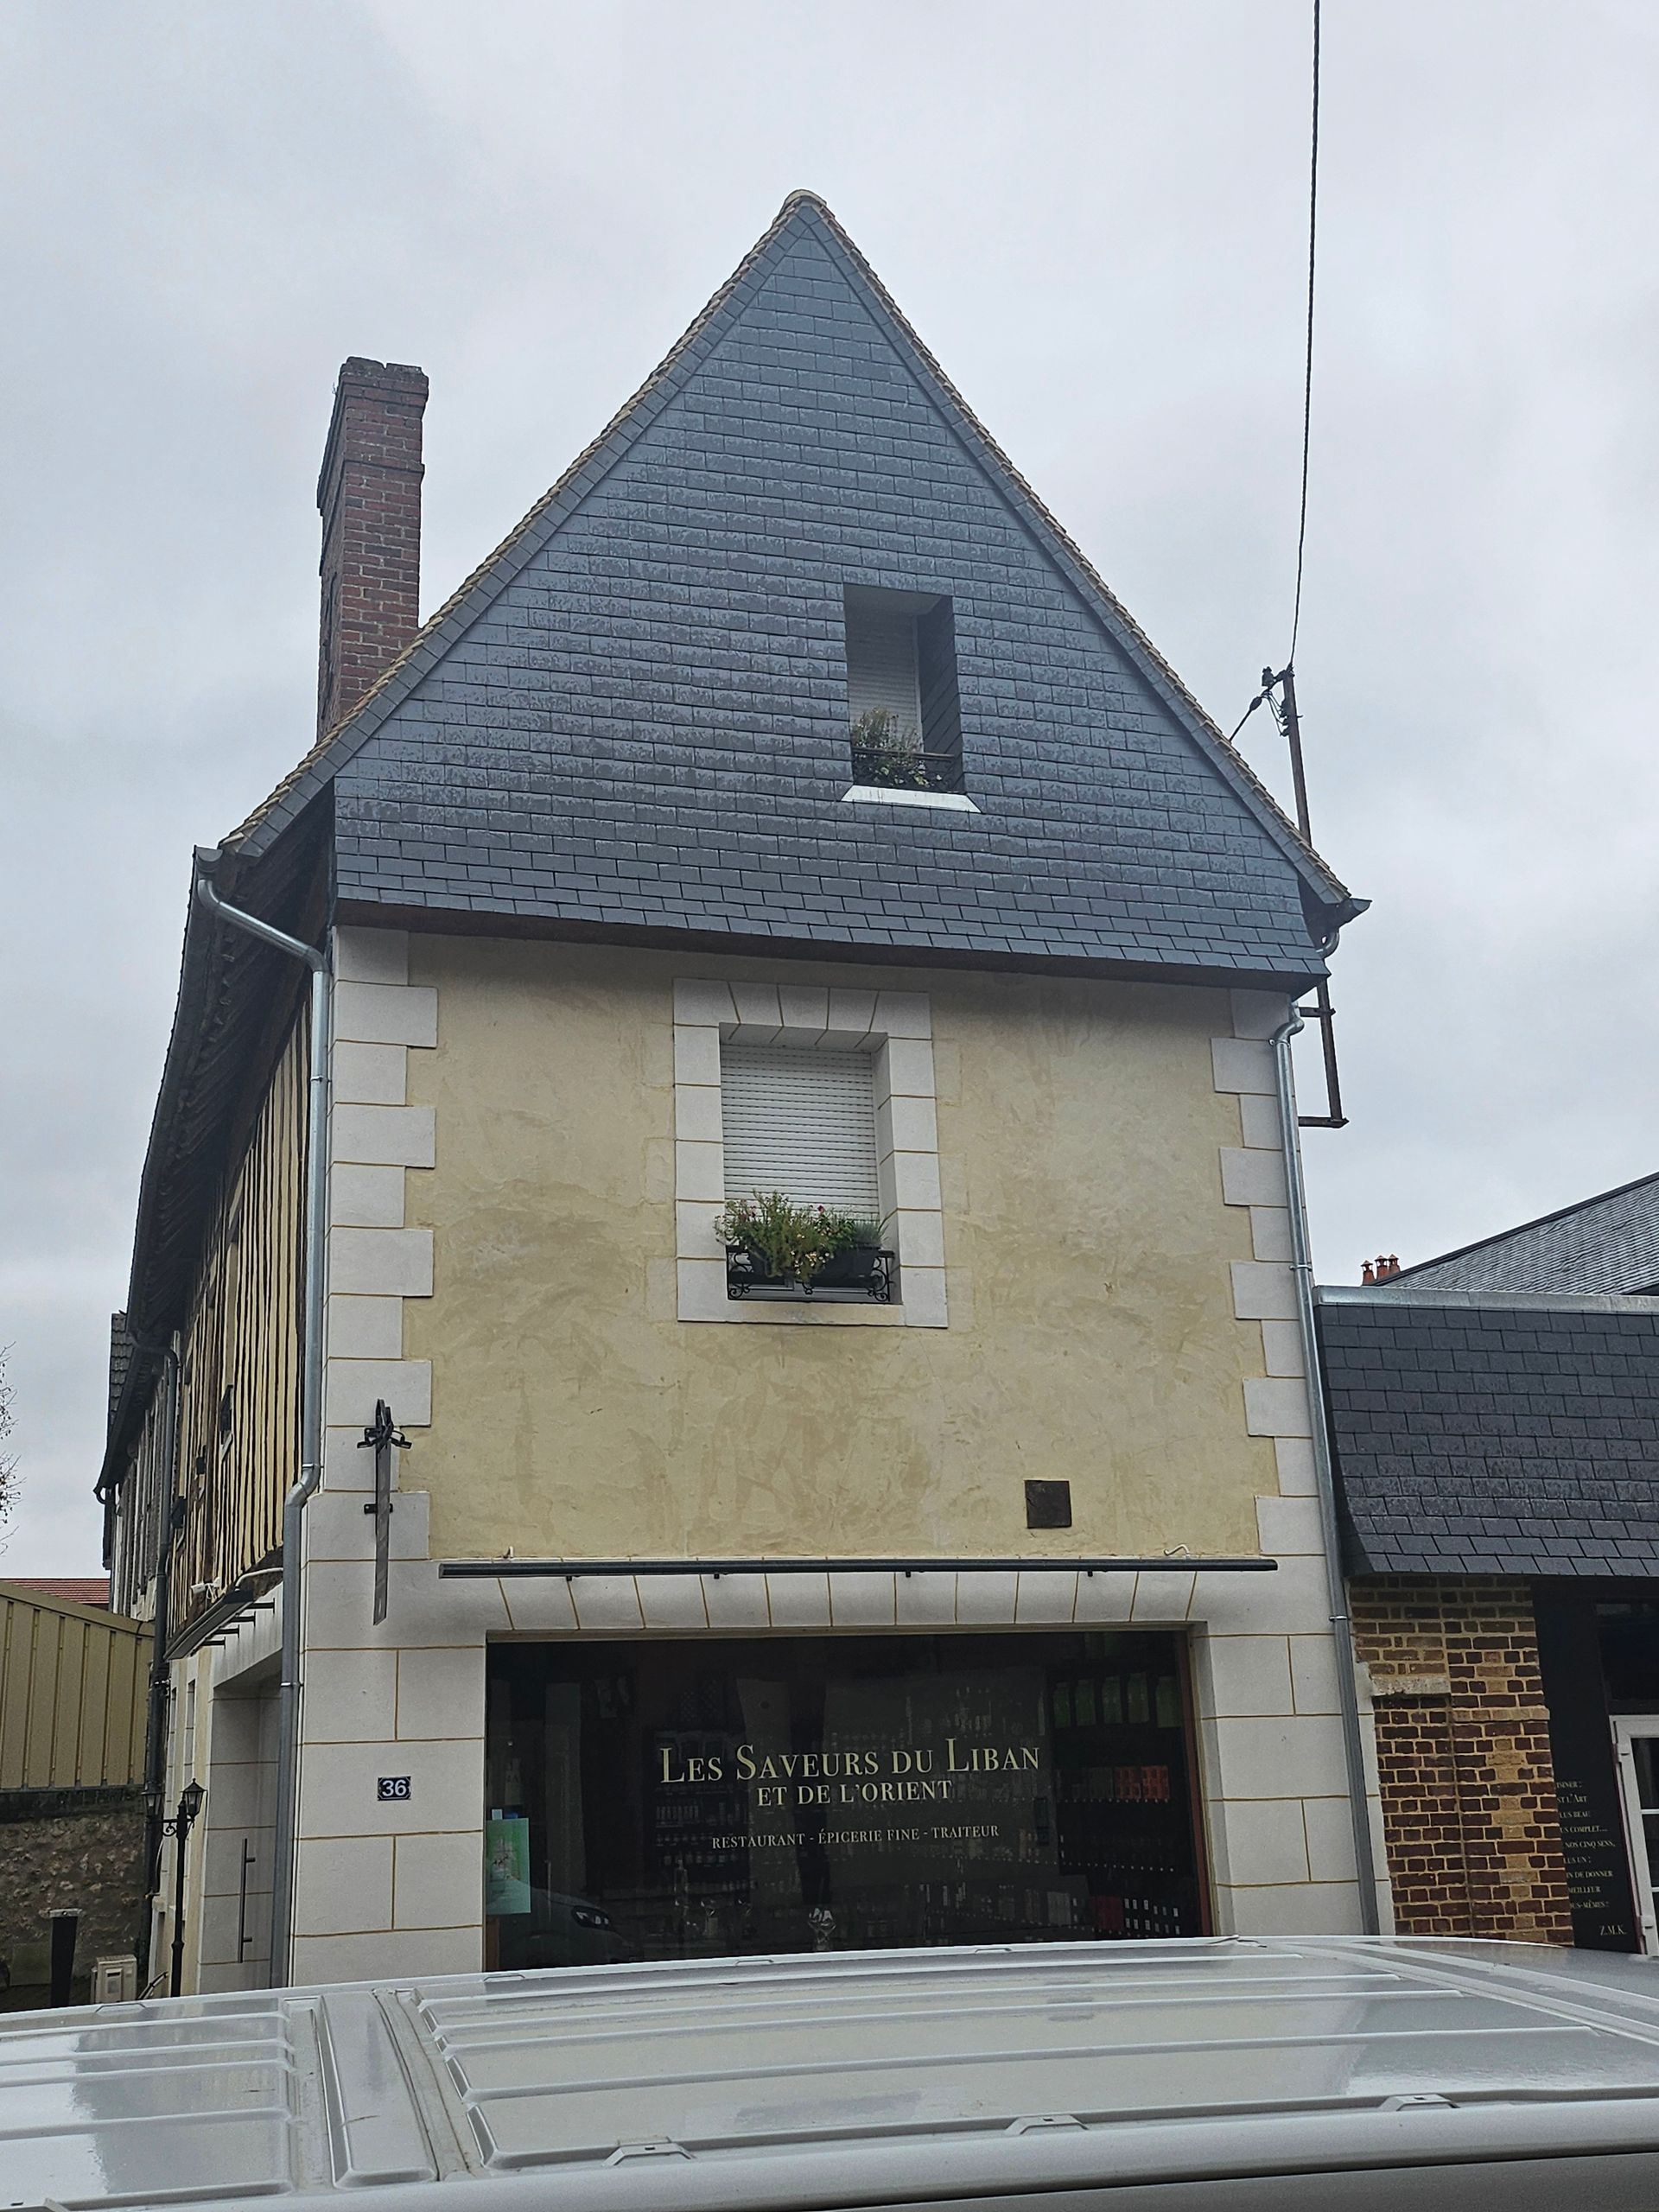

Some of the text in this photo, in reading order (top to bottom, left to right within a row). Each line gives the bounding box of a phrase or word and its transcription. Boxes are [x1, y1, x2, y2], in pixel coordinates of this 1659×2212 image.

[660, 1738, 1039, 1783] LES SAVEURS DU LIBAN
[382, 1779, 407, 1797] 36
[757, 1779, 953, 1807] ET DE L'ORIENT
[712, 1832, 805, 1850] RESTAURANT
[817, 1827, 883, 1845] ÉPICERIE
[887, 1827, 920, 1842] FINE
[931, 1824, 1000, 1840] TRAITEUR
